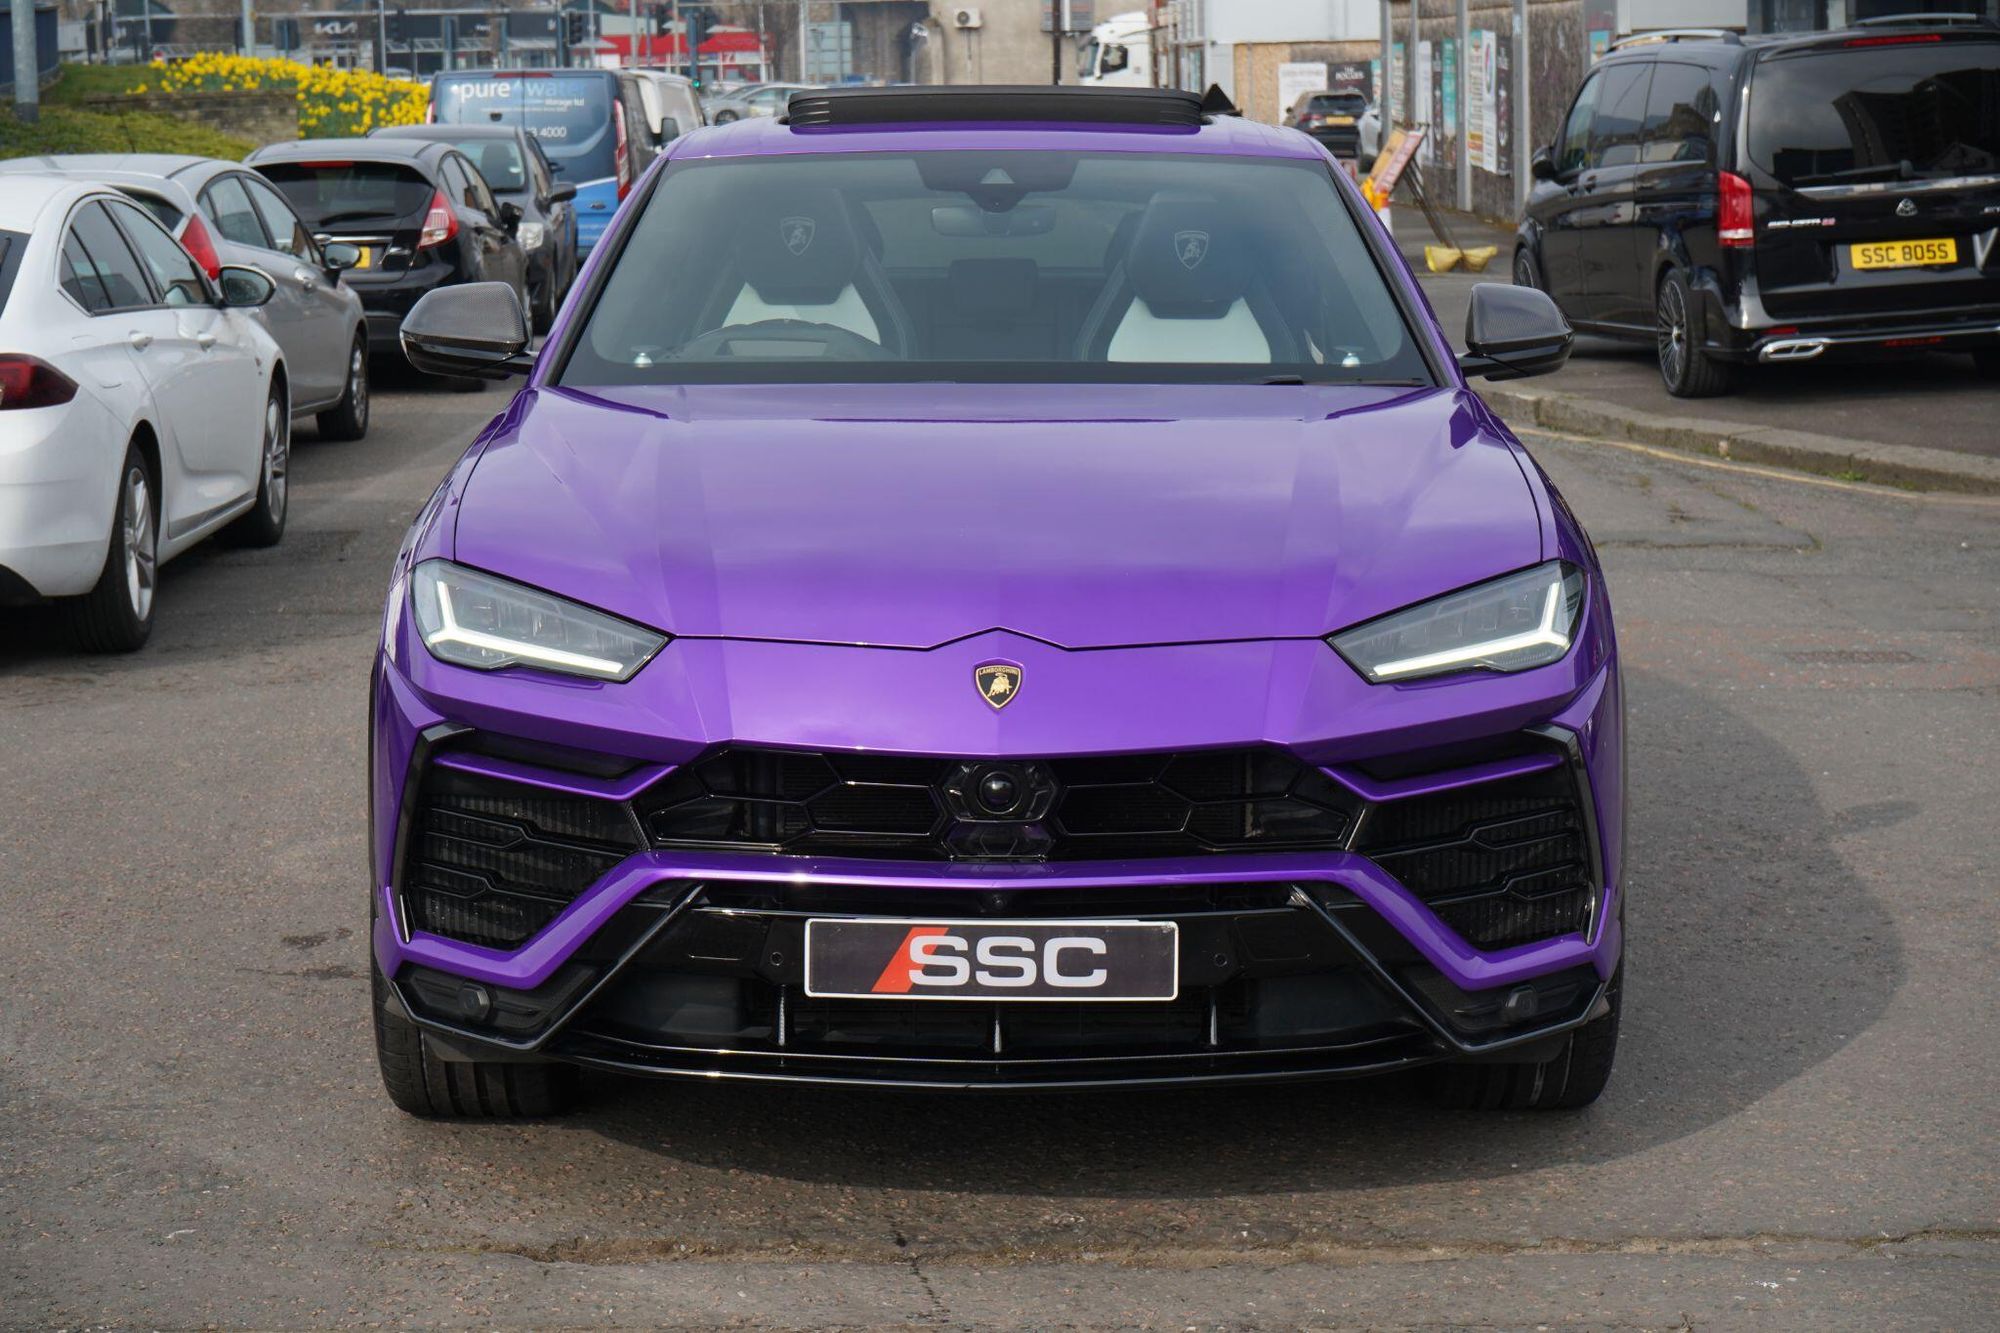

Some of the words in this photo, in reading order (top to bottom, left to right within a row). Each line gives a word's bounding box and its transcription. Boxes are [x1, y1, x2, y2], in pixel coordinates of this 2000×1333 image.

[461, 81, 511, 103] pure
[1861, 247, 1896, 264] SSC
[909, 935, 1107, 987] SSC
